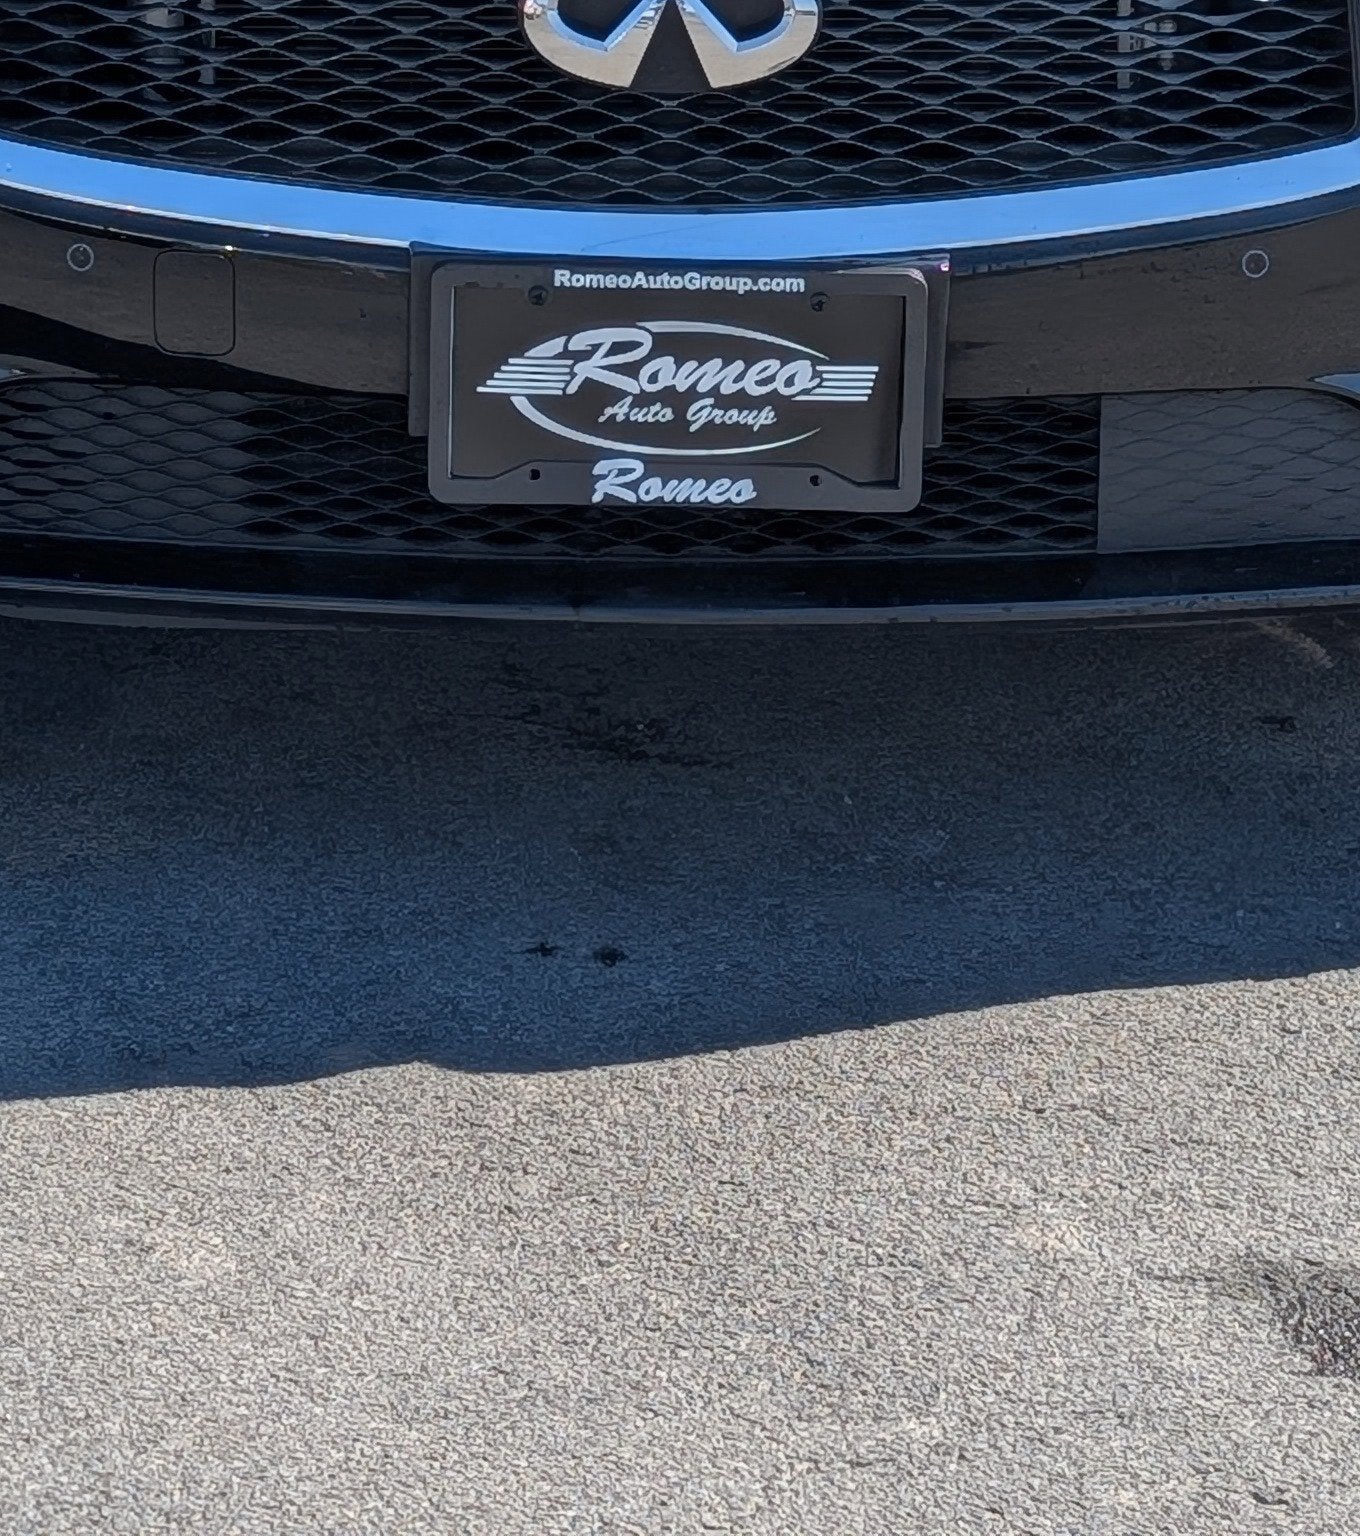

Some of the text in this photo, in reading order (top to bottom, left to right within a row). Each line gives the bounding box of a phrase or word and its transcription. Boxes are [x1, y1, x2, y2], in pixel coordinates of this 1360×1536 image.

[553, 269, 805, 295] RomeoAutoGroup.com
[566, 325, 821, 397] Romeo
[598, 396, 777, 433] Auto Group
[590, 458, 758, 505] Romeo
